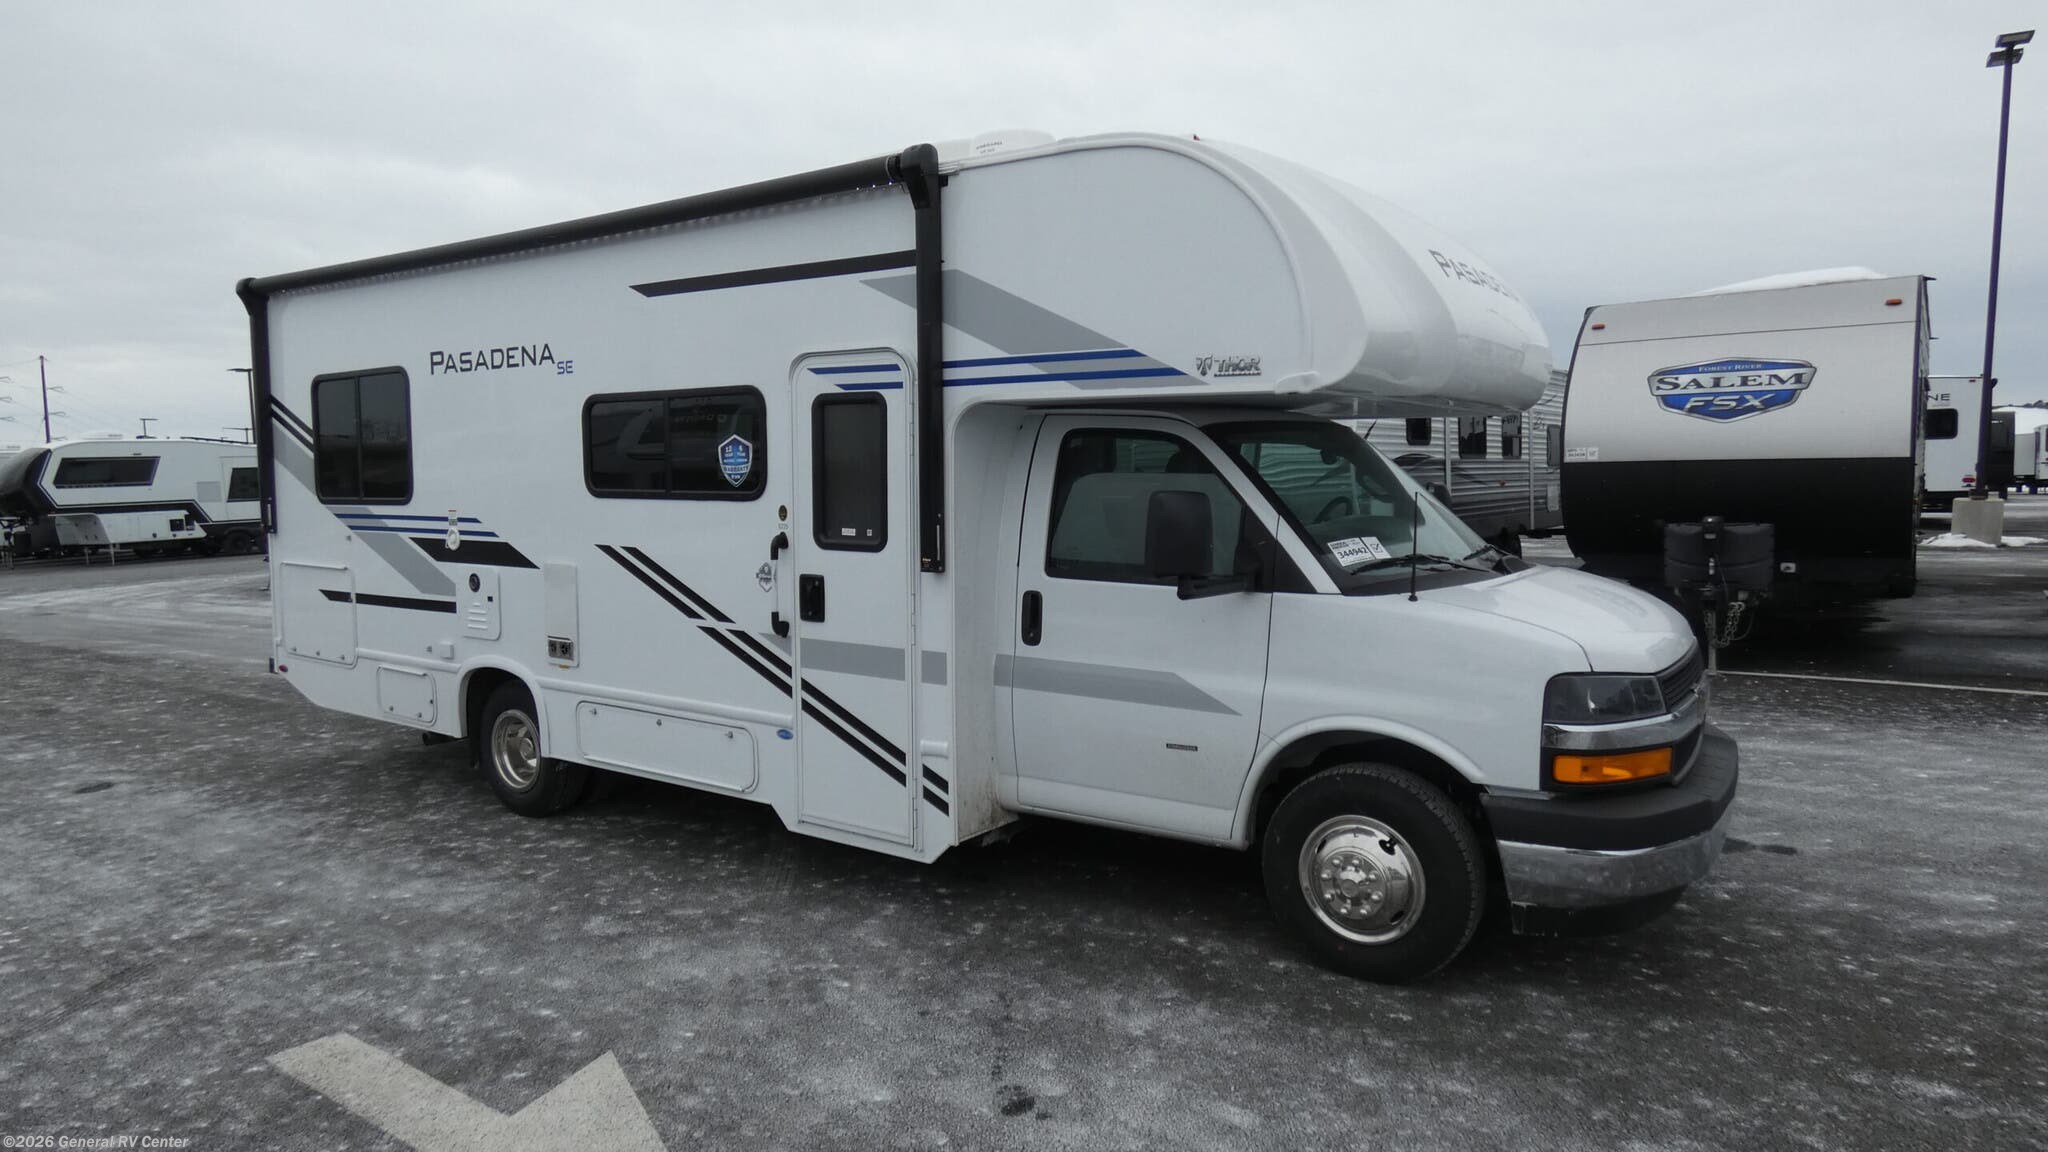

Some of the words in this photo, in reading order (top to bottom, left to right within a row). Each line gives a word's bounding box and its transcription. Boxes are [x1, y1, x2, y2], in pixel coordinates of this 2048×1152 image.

[430, 343, 556, 376] PASADENA
[556, 360, 574, 375] SE
[1655, 372, 1809, 391] SALEM
[1683, 394, 1776, 412] FSX
